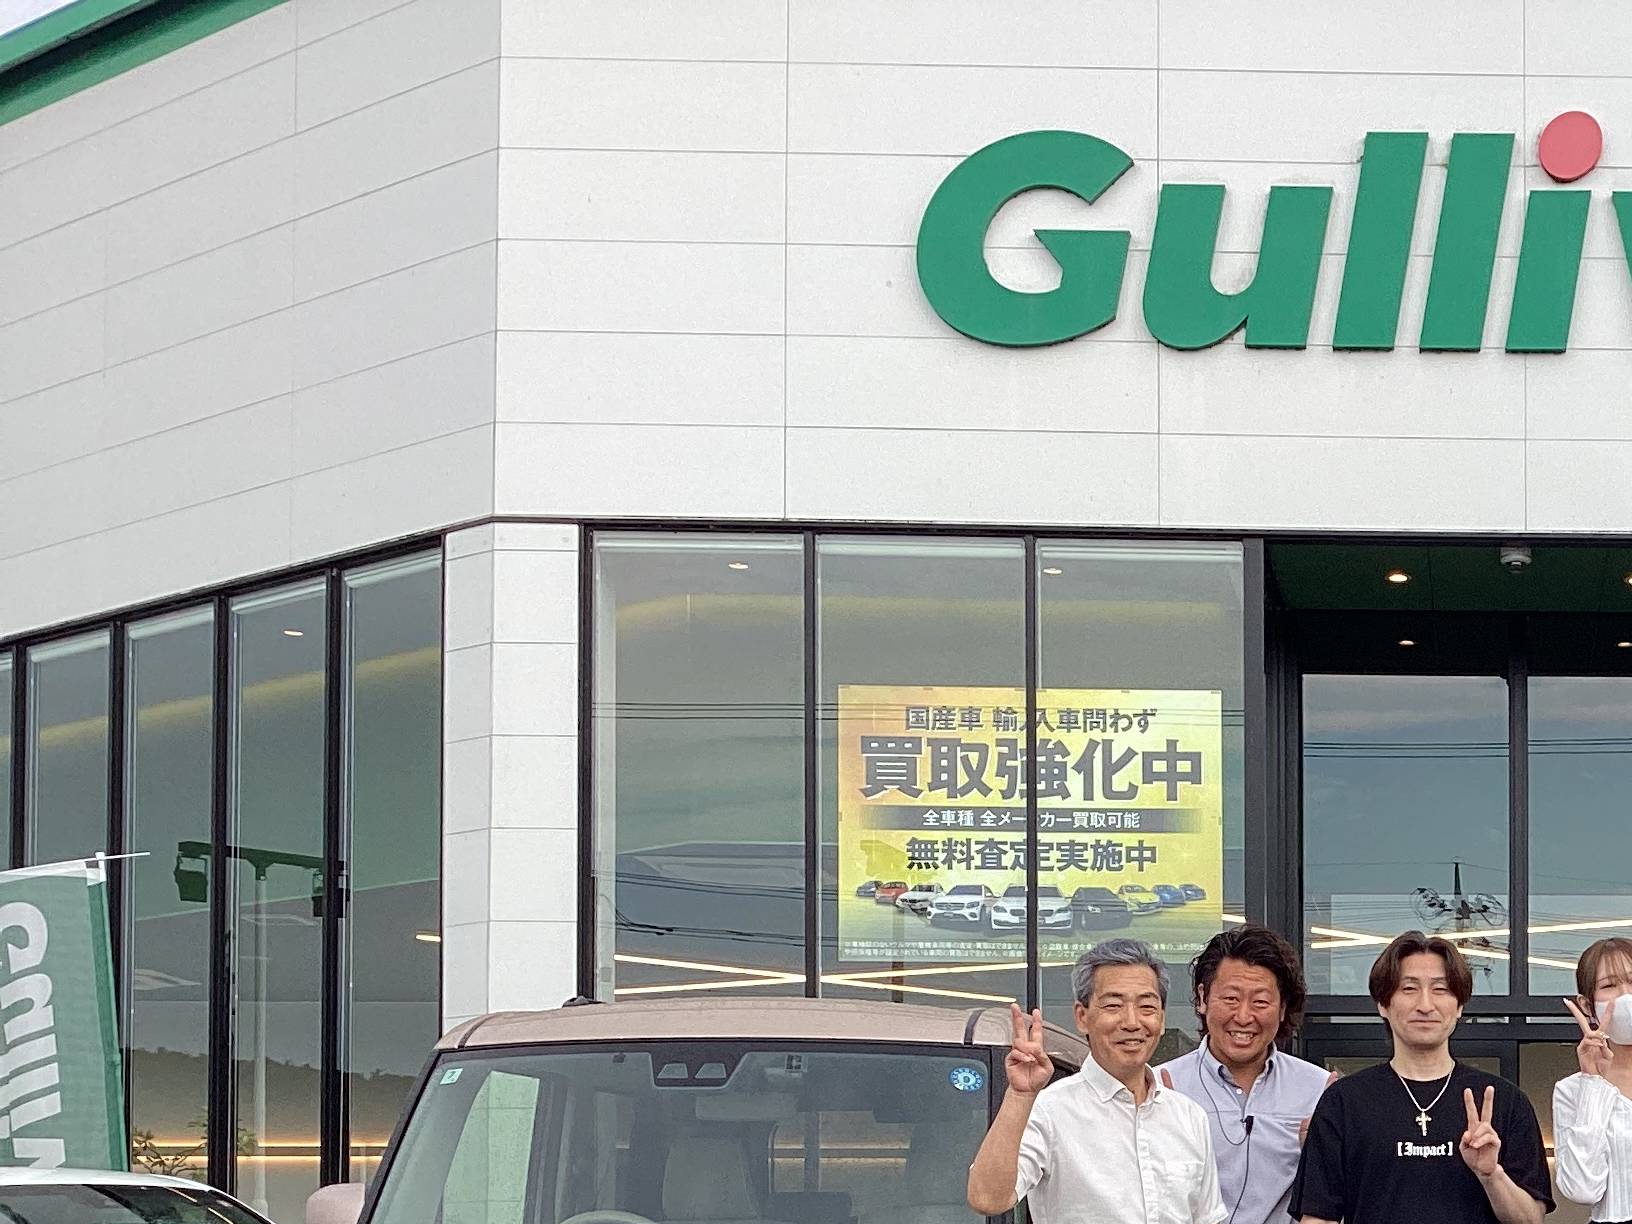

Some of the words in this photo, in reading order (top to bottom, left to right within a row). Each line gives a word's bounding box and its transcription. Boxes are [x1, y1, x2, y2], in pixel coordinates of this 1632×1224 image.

[905, 706, 984, 731] 国産車
[992, 706, 1158, 734] 輸入車問わず
[859, 736, 1203, 802] 買取強化中
[922, 809, 974, 827] 全車種
[906, 837, 1158, 873] 無料査定実施中
